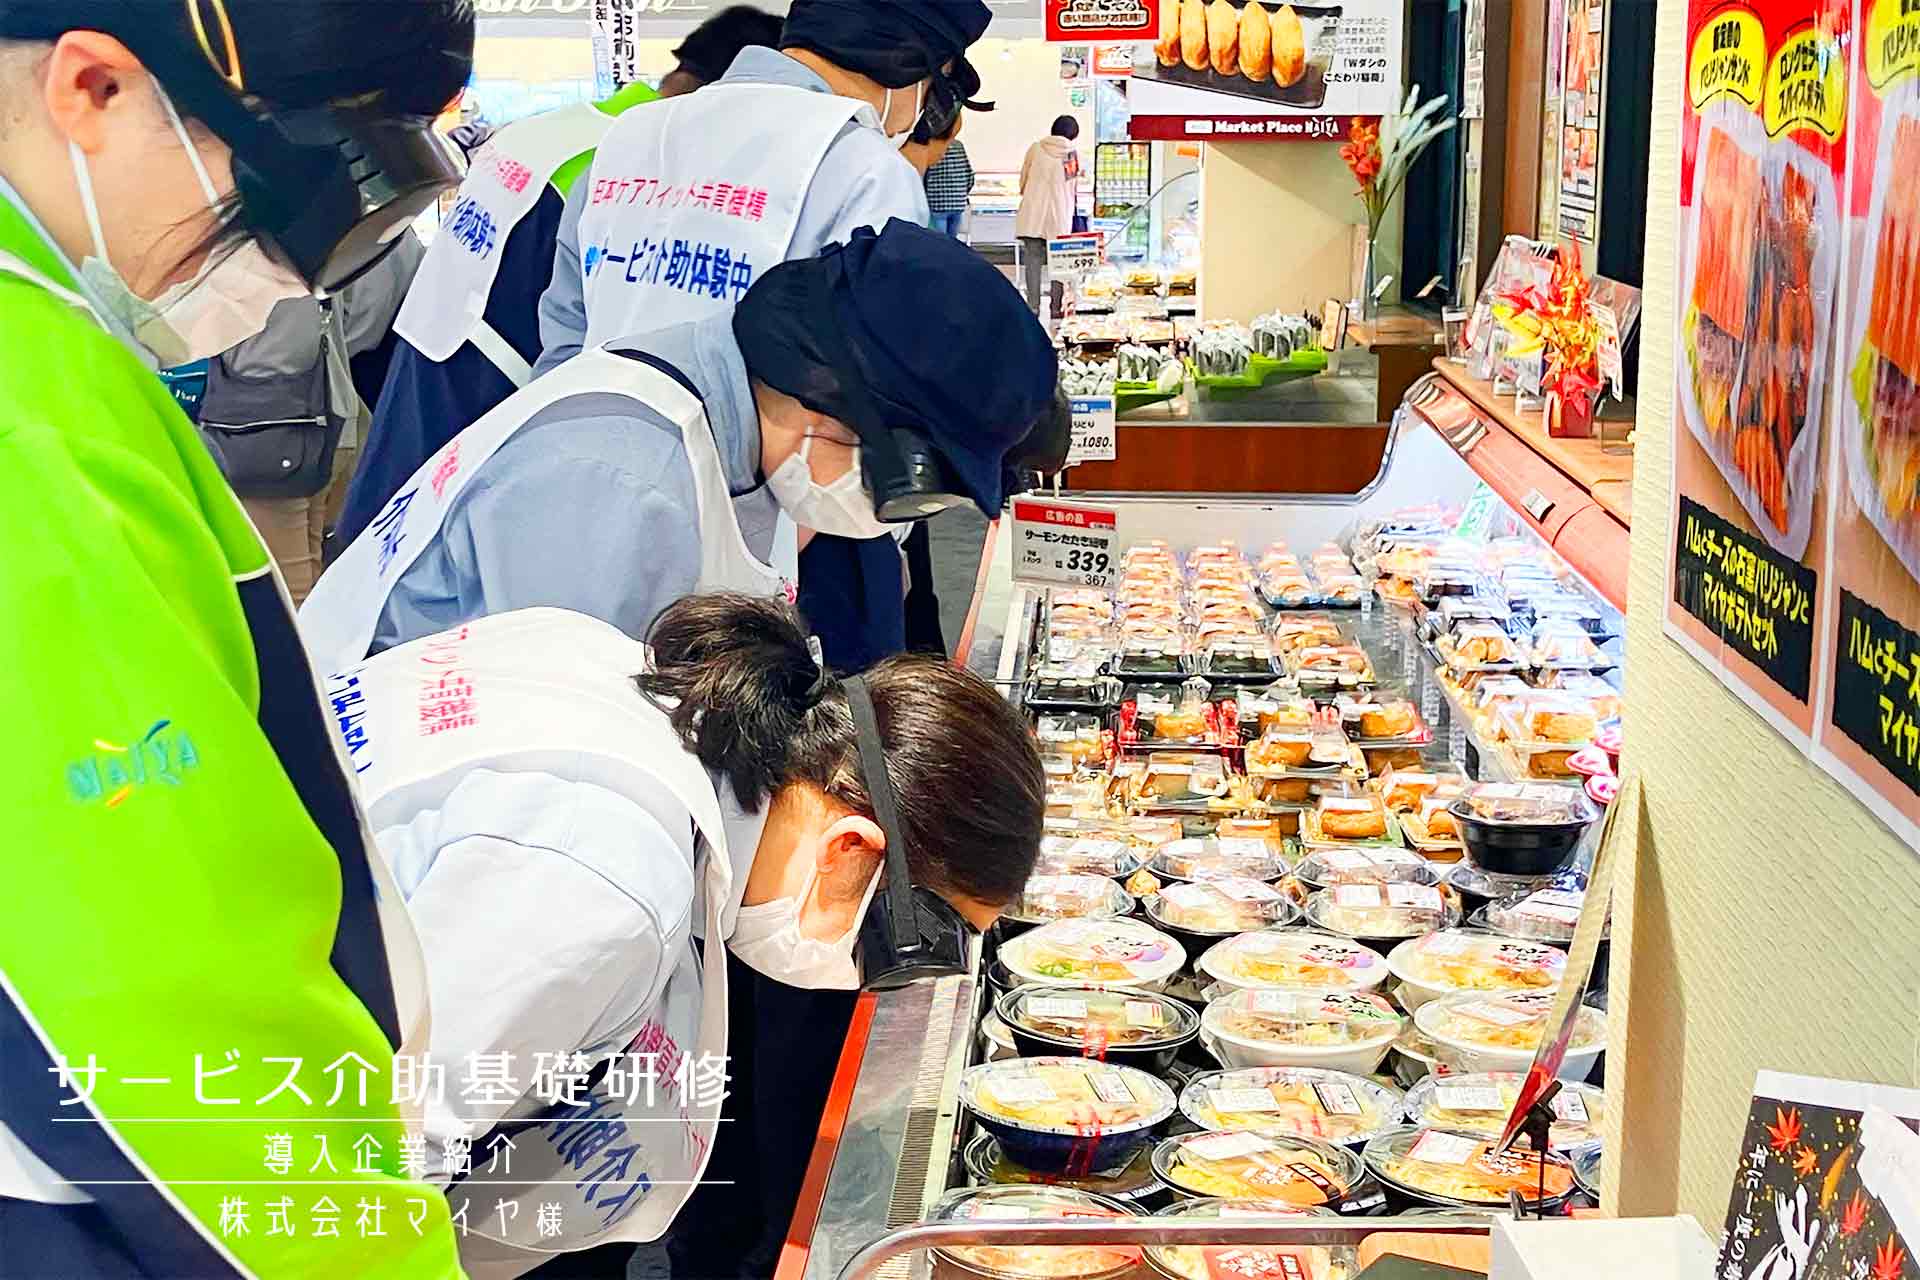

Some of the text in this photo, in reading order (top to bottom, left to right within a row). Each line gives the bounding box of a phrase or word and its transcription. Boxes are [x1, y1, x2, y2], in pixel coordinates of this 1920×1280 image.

[1214, 121, 1264, 134] Market
[1267, 121, 1303, 134] Place
[1067, 550, 1109, 573] 339
[1085, 574, 1107, 588] 367
